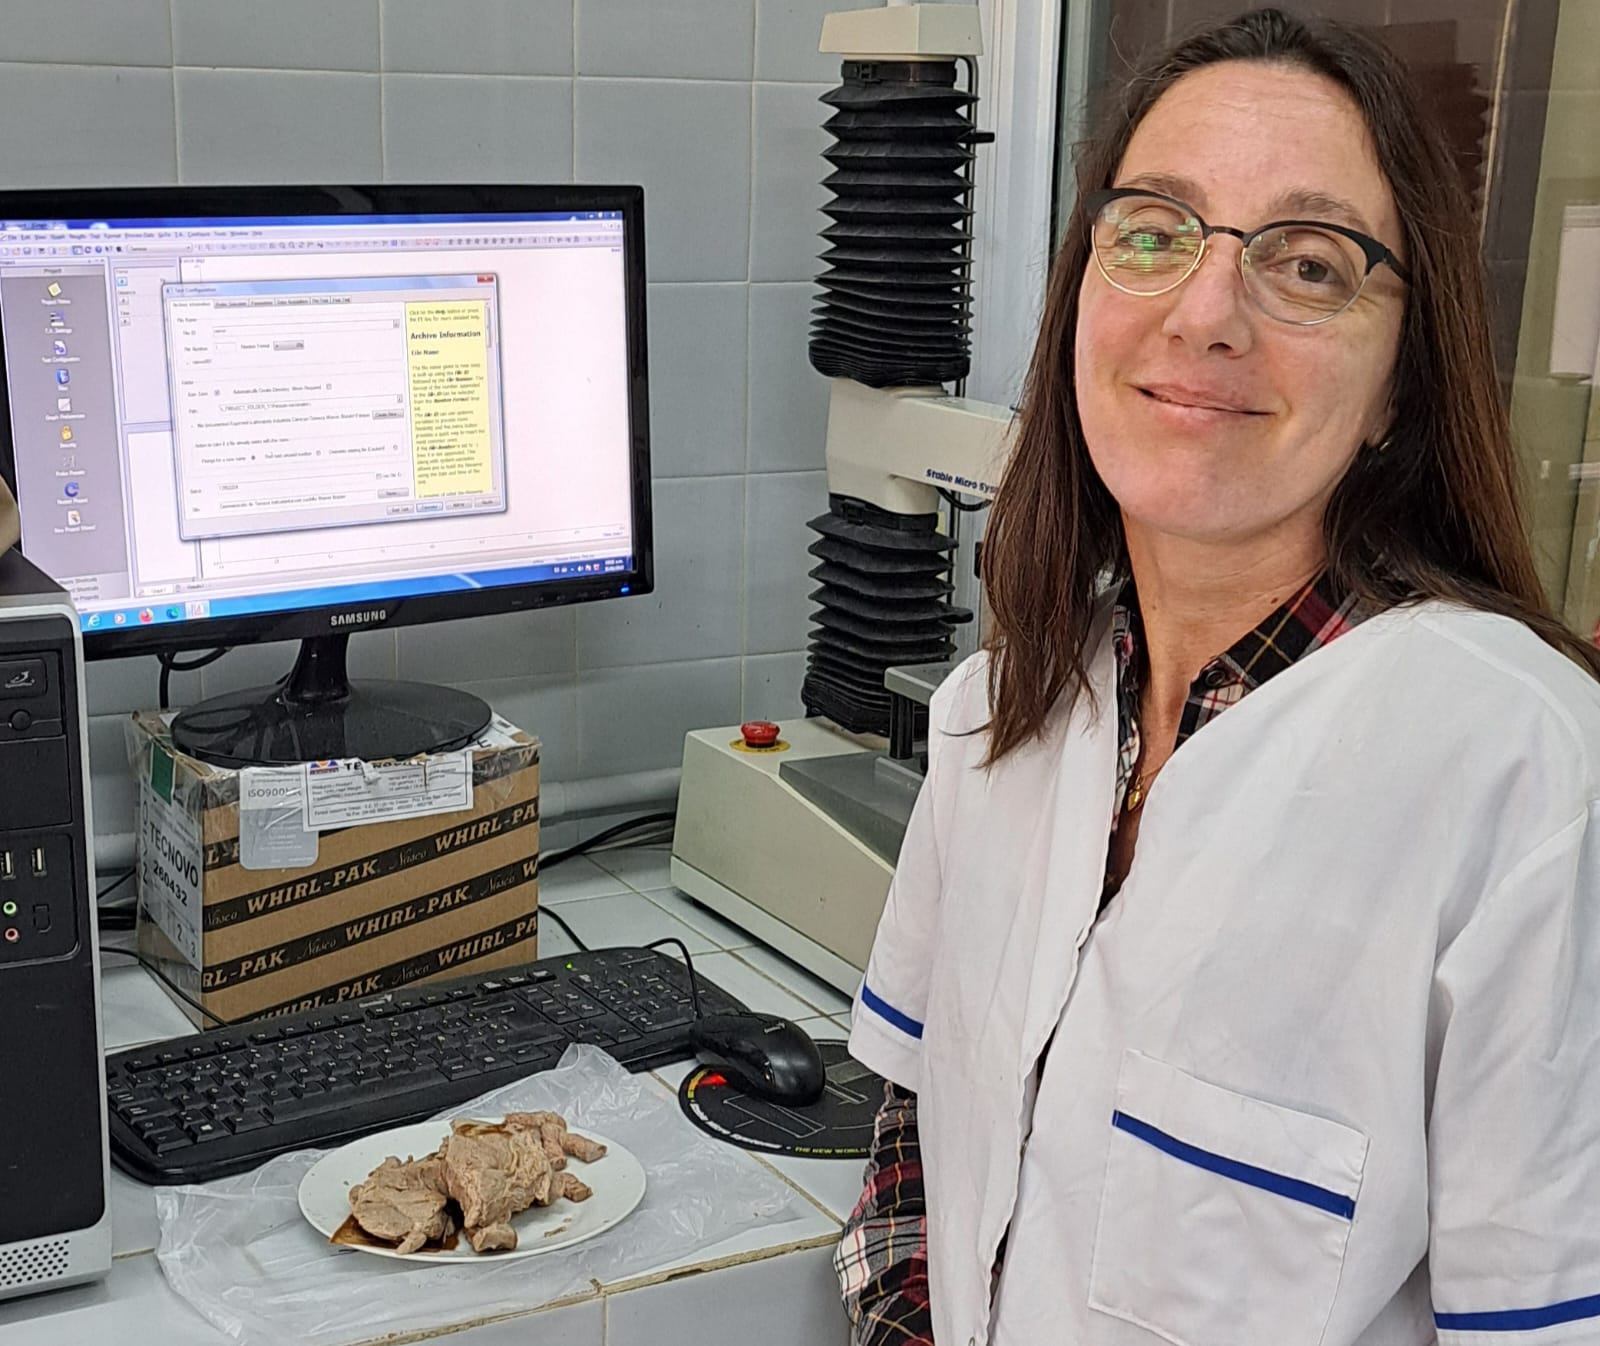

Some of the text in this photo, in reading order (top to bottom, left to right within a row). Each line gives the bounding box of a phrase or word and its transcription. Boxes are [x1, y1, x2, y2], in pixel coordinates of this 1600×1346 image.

[411, 330, 481, 340] Archive Information
[926, 468, 953, 483] Stable
[954, 476, 978, 489] Micro
[330, 609, 387, 627] SAMSUNG
[435, 802, 536, 853] WHIRL-PA
[149, 820, 200, 889] TECNOVO
[247, 858, 380, 915] WHIRL-PAK
[345, 884, 471, 943] WHIRL-PAK
